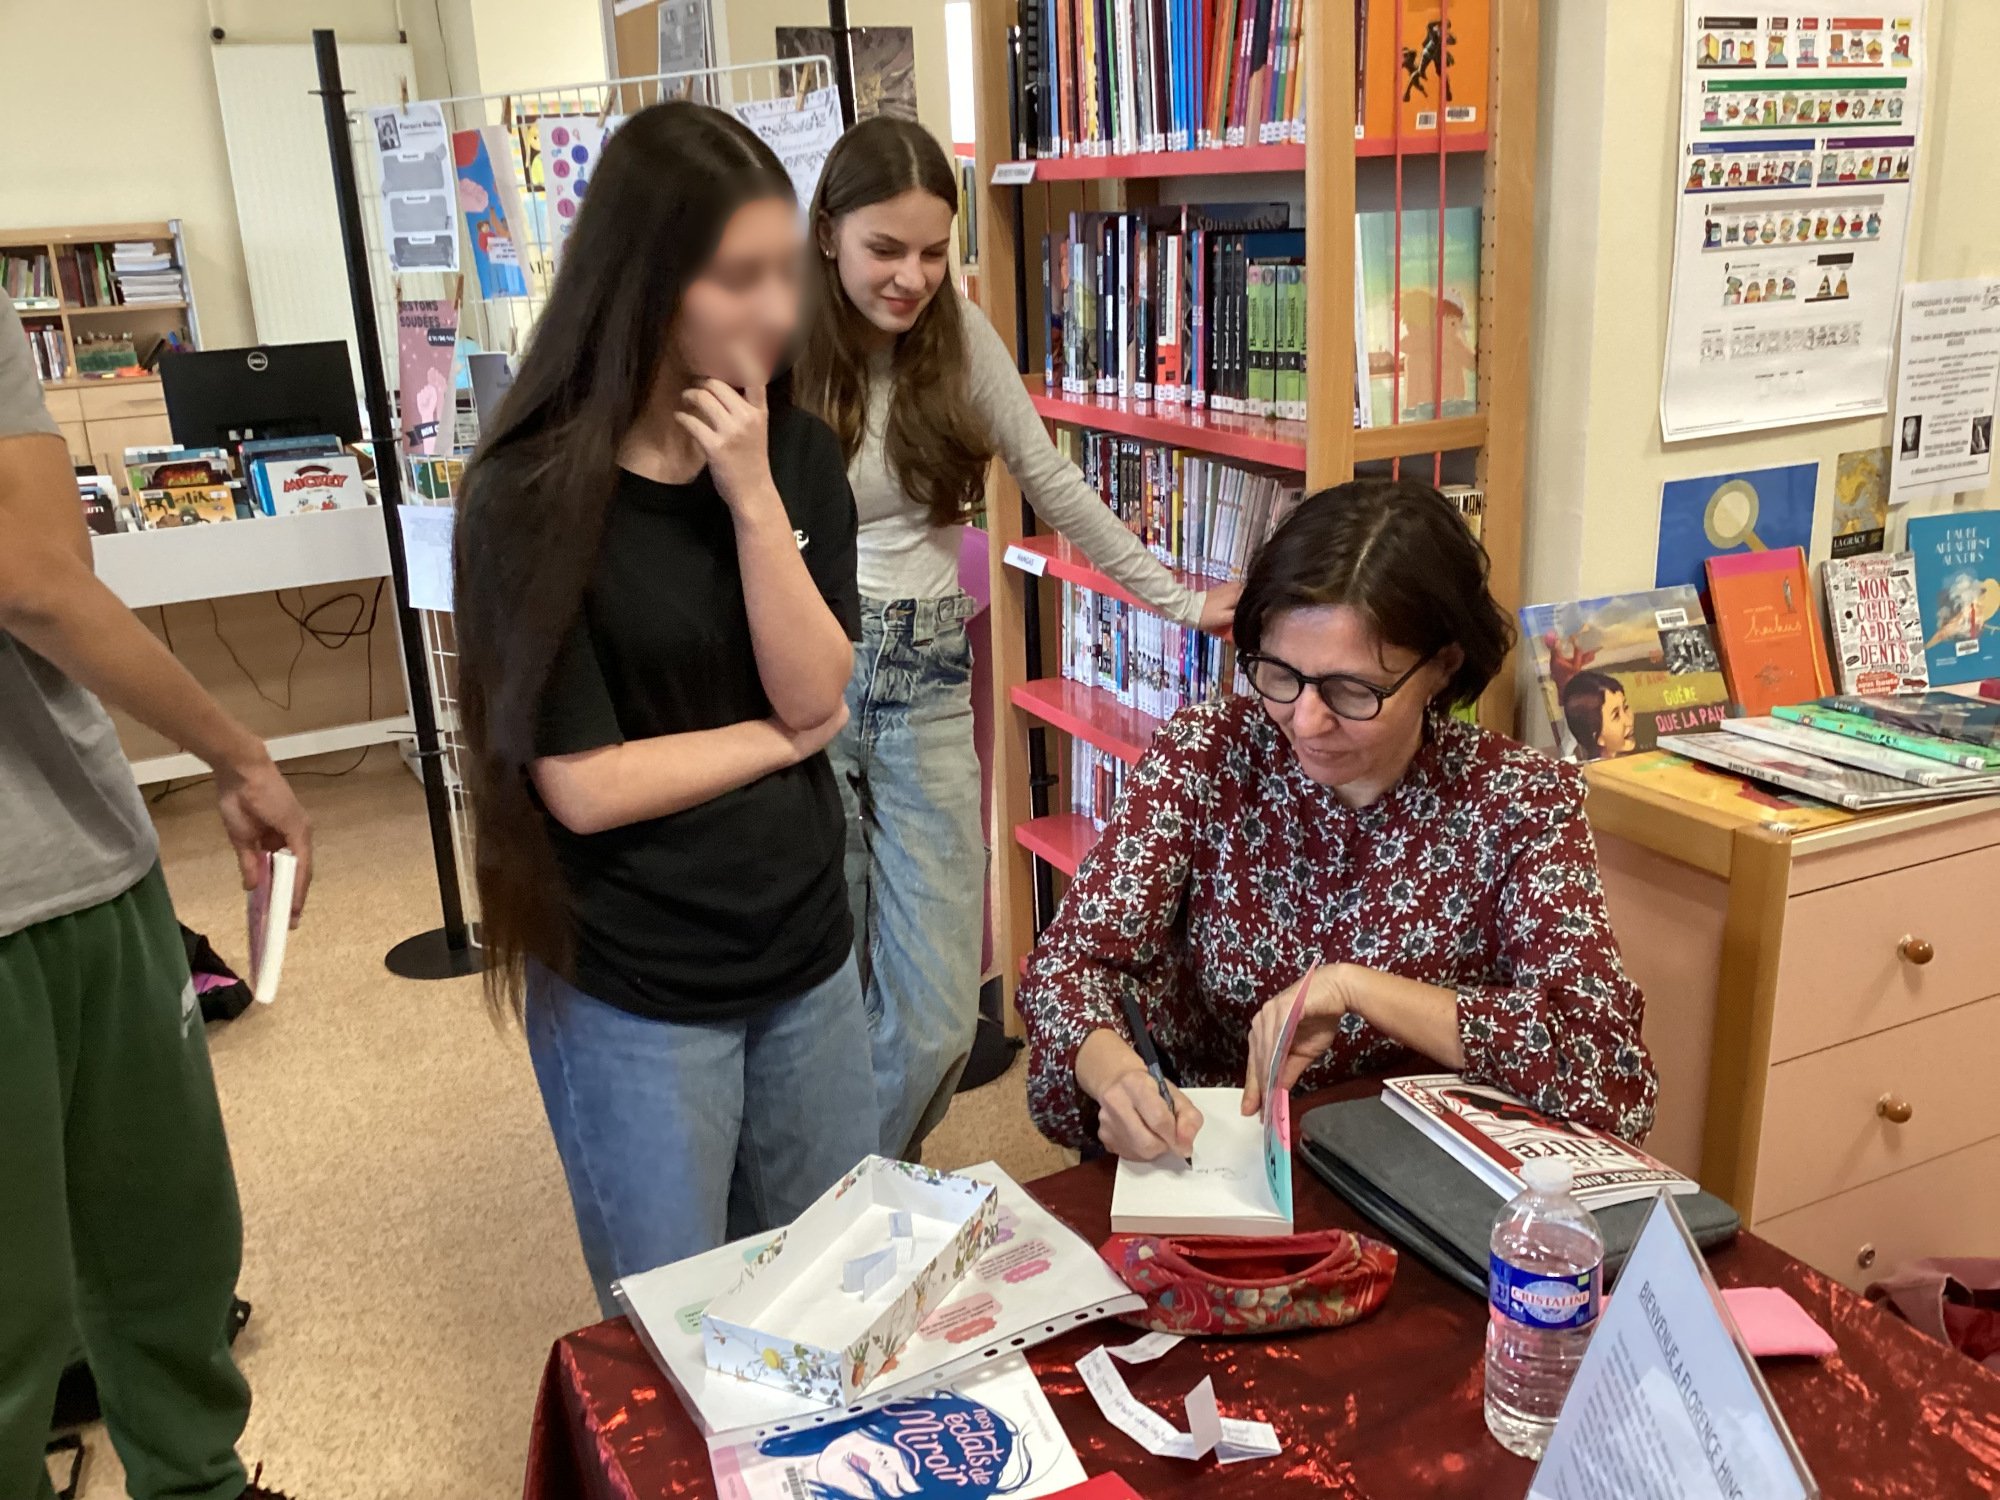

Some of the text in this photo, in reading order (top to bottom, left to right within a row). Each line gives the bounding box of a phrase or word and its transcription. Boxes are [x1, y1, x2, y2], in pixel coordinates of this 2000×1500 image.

[283, 474, 348, 493] MICKEY
[1858, 578, 1889, 601] MON
[1876, 620, 1902, 642] DES
[1860, 640, 1908, 666] DENTS
[1656, 704, 1727, 733] QUE LA PAIX
[1604, 1169, 1683, 1184] FLORENCE
[1512, 1287, 1588, 1309] CRISTALINE
[1639, 1280, 1680, 1367] BIENVENUE
[1679, 1372, 1723, 1465] FLORENCE
[973, 1408, 995, 1429] nos
[882, 1404, 969, 1487] Miroir
[944, 1411, 1004, 1485] éclats de
